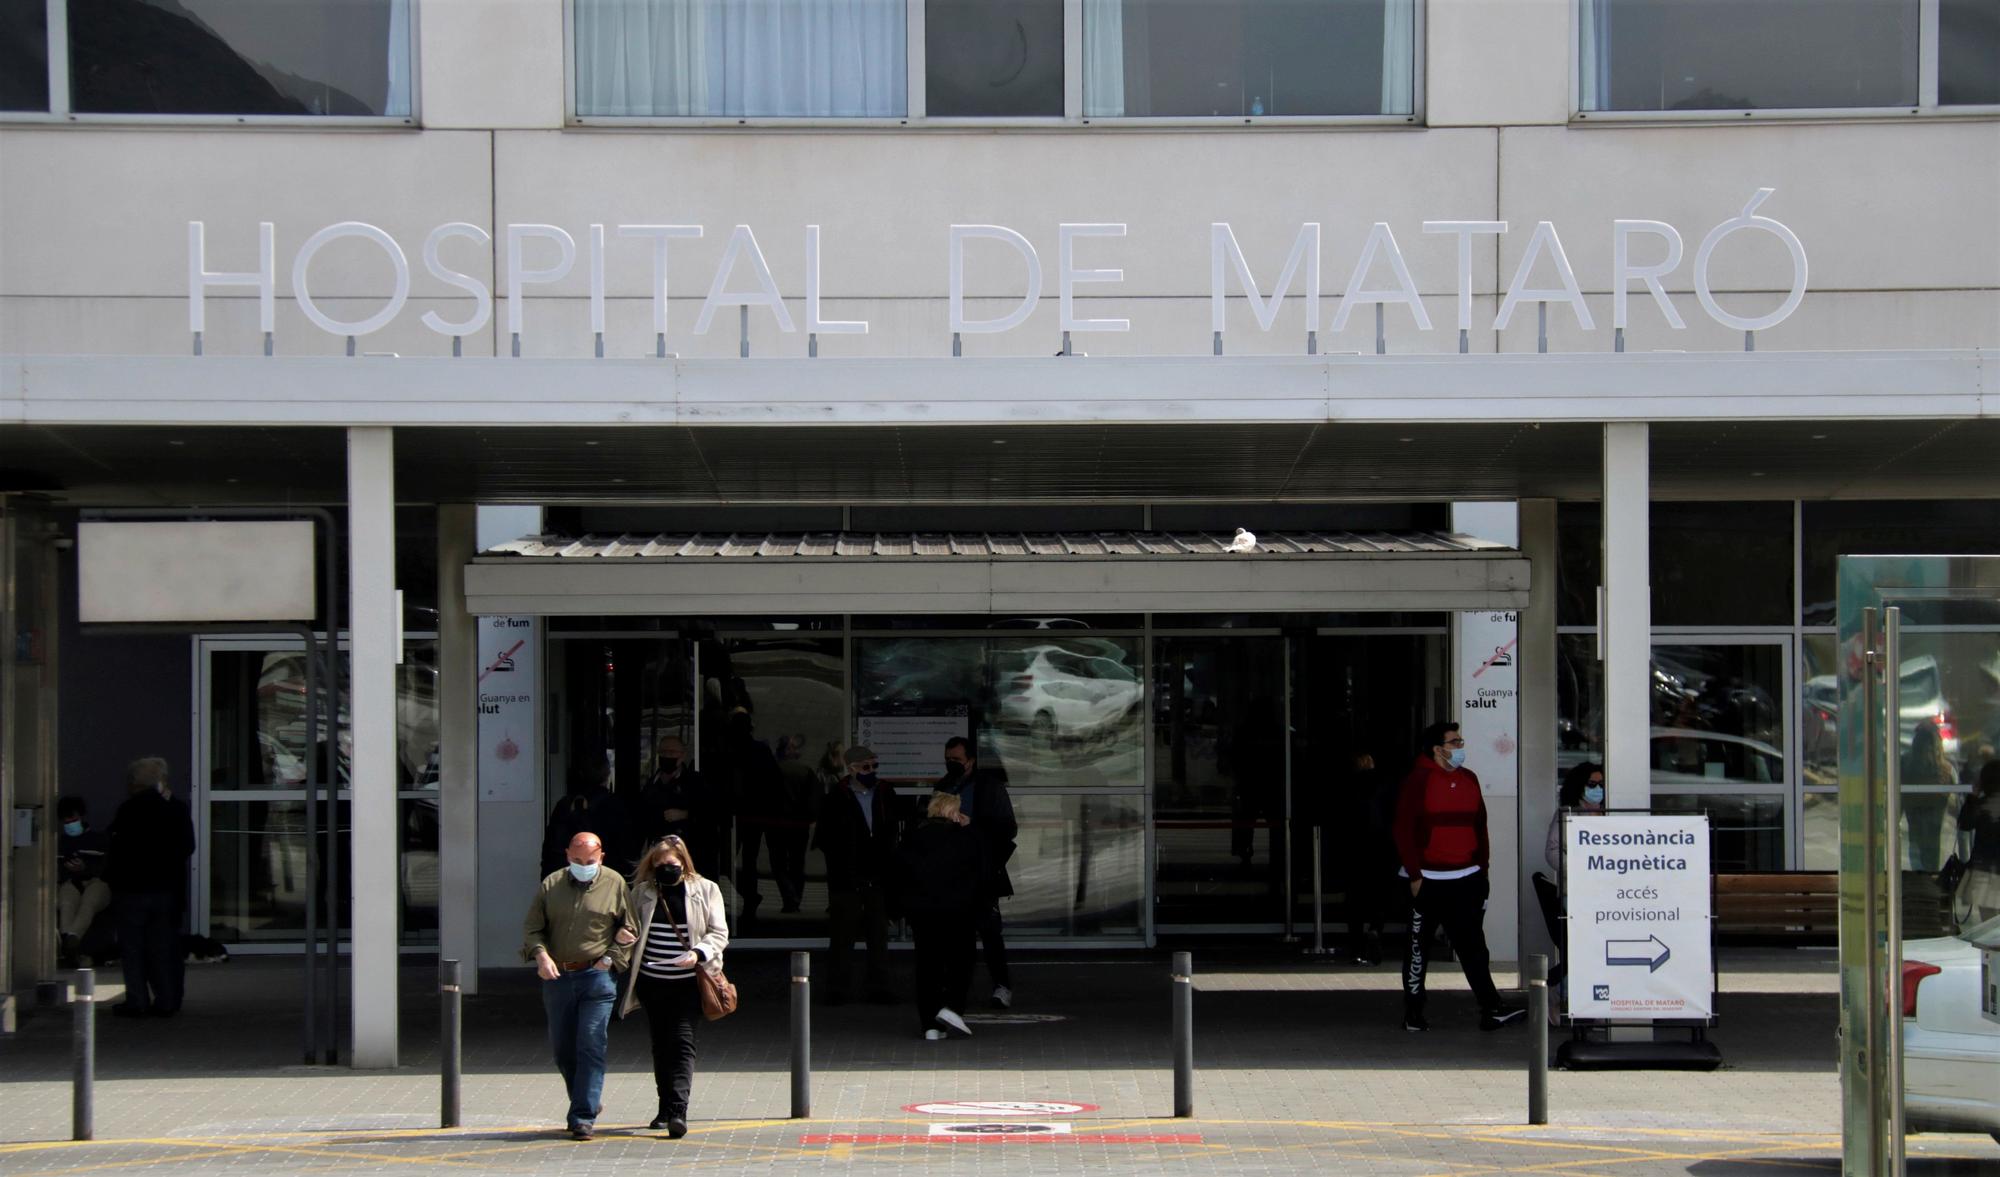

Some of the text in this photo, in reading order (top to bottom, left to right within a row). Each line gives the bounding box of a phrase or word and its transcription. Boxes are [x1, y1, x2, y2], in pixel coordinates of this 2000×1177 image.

[188, 187, 1810, 336] HOSPITAL DE MATARÓ
[493, 618, 530, 628] de fum
[1490, 613, 1516, 623] de fu
[480, 694, 530, 704] Guanya en
[1477, 688, 1513, 699] Guanya
[1465, 698, 1497, 708] salut
[1578, 829, 1695, 846] Ressonància
[1587, 854, 1687, 875] Magnètica
[1616, 886, 1658, 900] accés
[1595, 907, 1680, 924] provisional
[1610, 999, 1643, 1007] HOSPITAL
